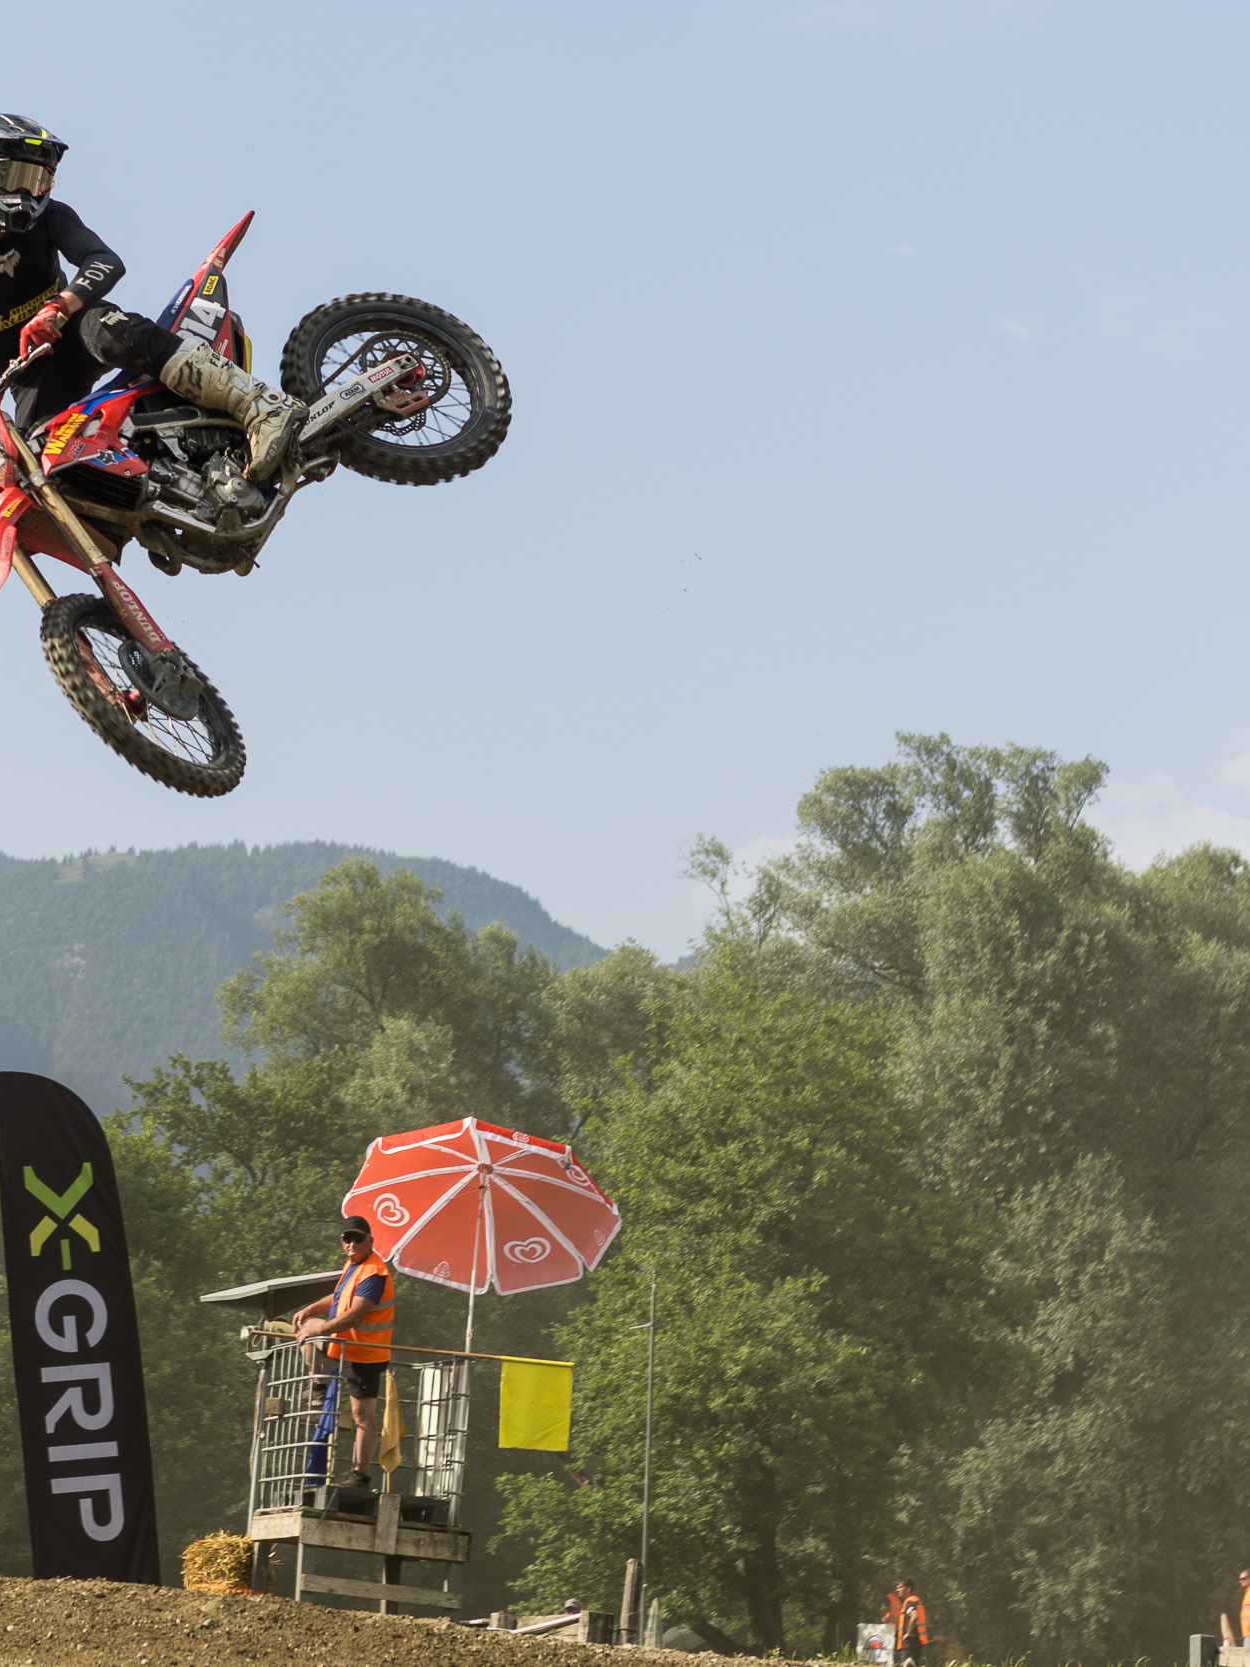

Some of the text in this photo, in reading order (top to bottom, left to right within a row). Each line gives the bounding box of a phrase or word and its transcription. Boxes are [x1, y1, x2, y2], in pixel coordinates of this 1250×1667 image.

[76, 260, 114, 291] FOX
[204, 277, 218, 294] ADAC
[174, 284, 192, 312] HONDA
[370, 367, 393, 382] MOTUL
[344, 385, 361, 398] AFAM
[112, 580, 162, 643] DUNLOP
[23, 1162, 125, 1542] X-GRIP
